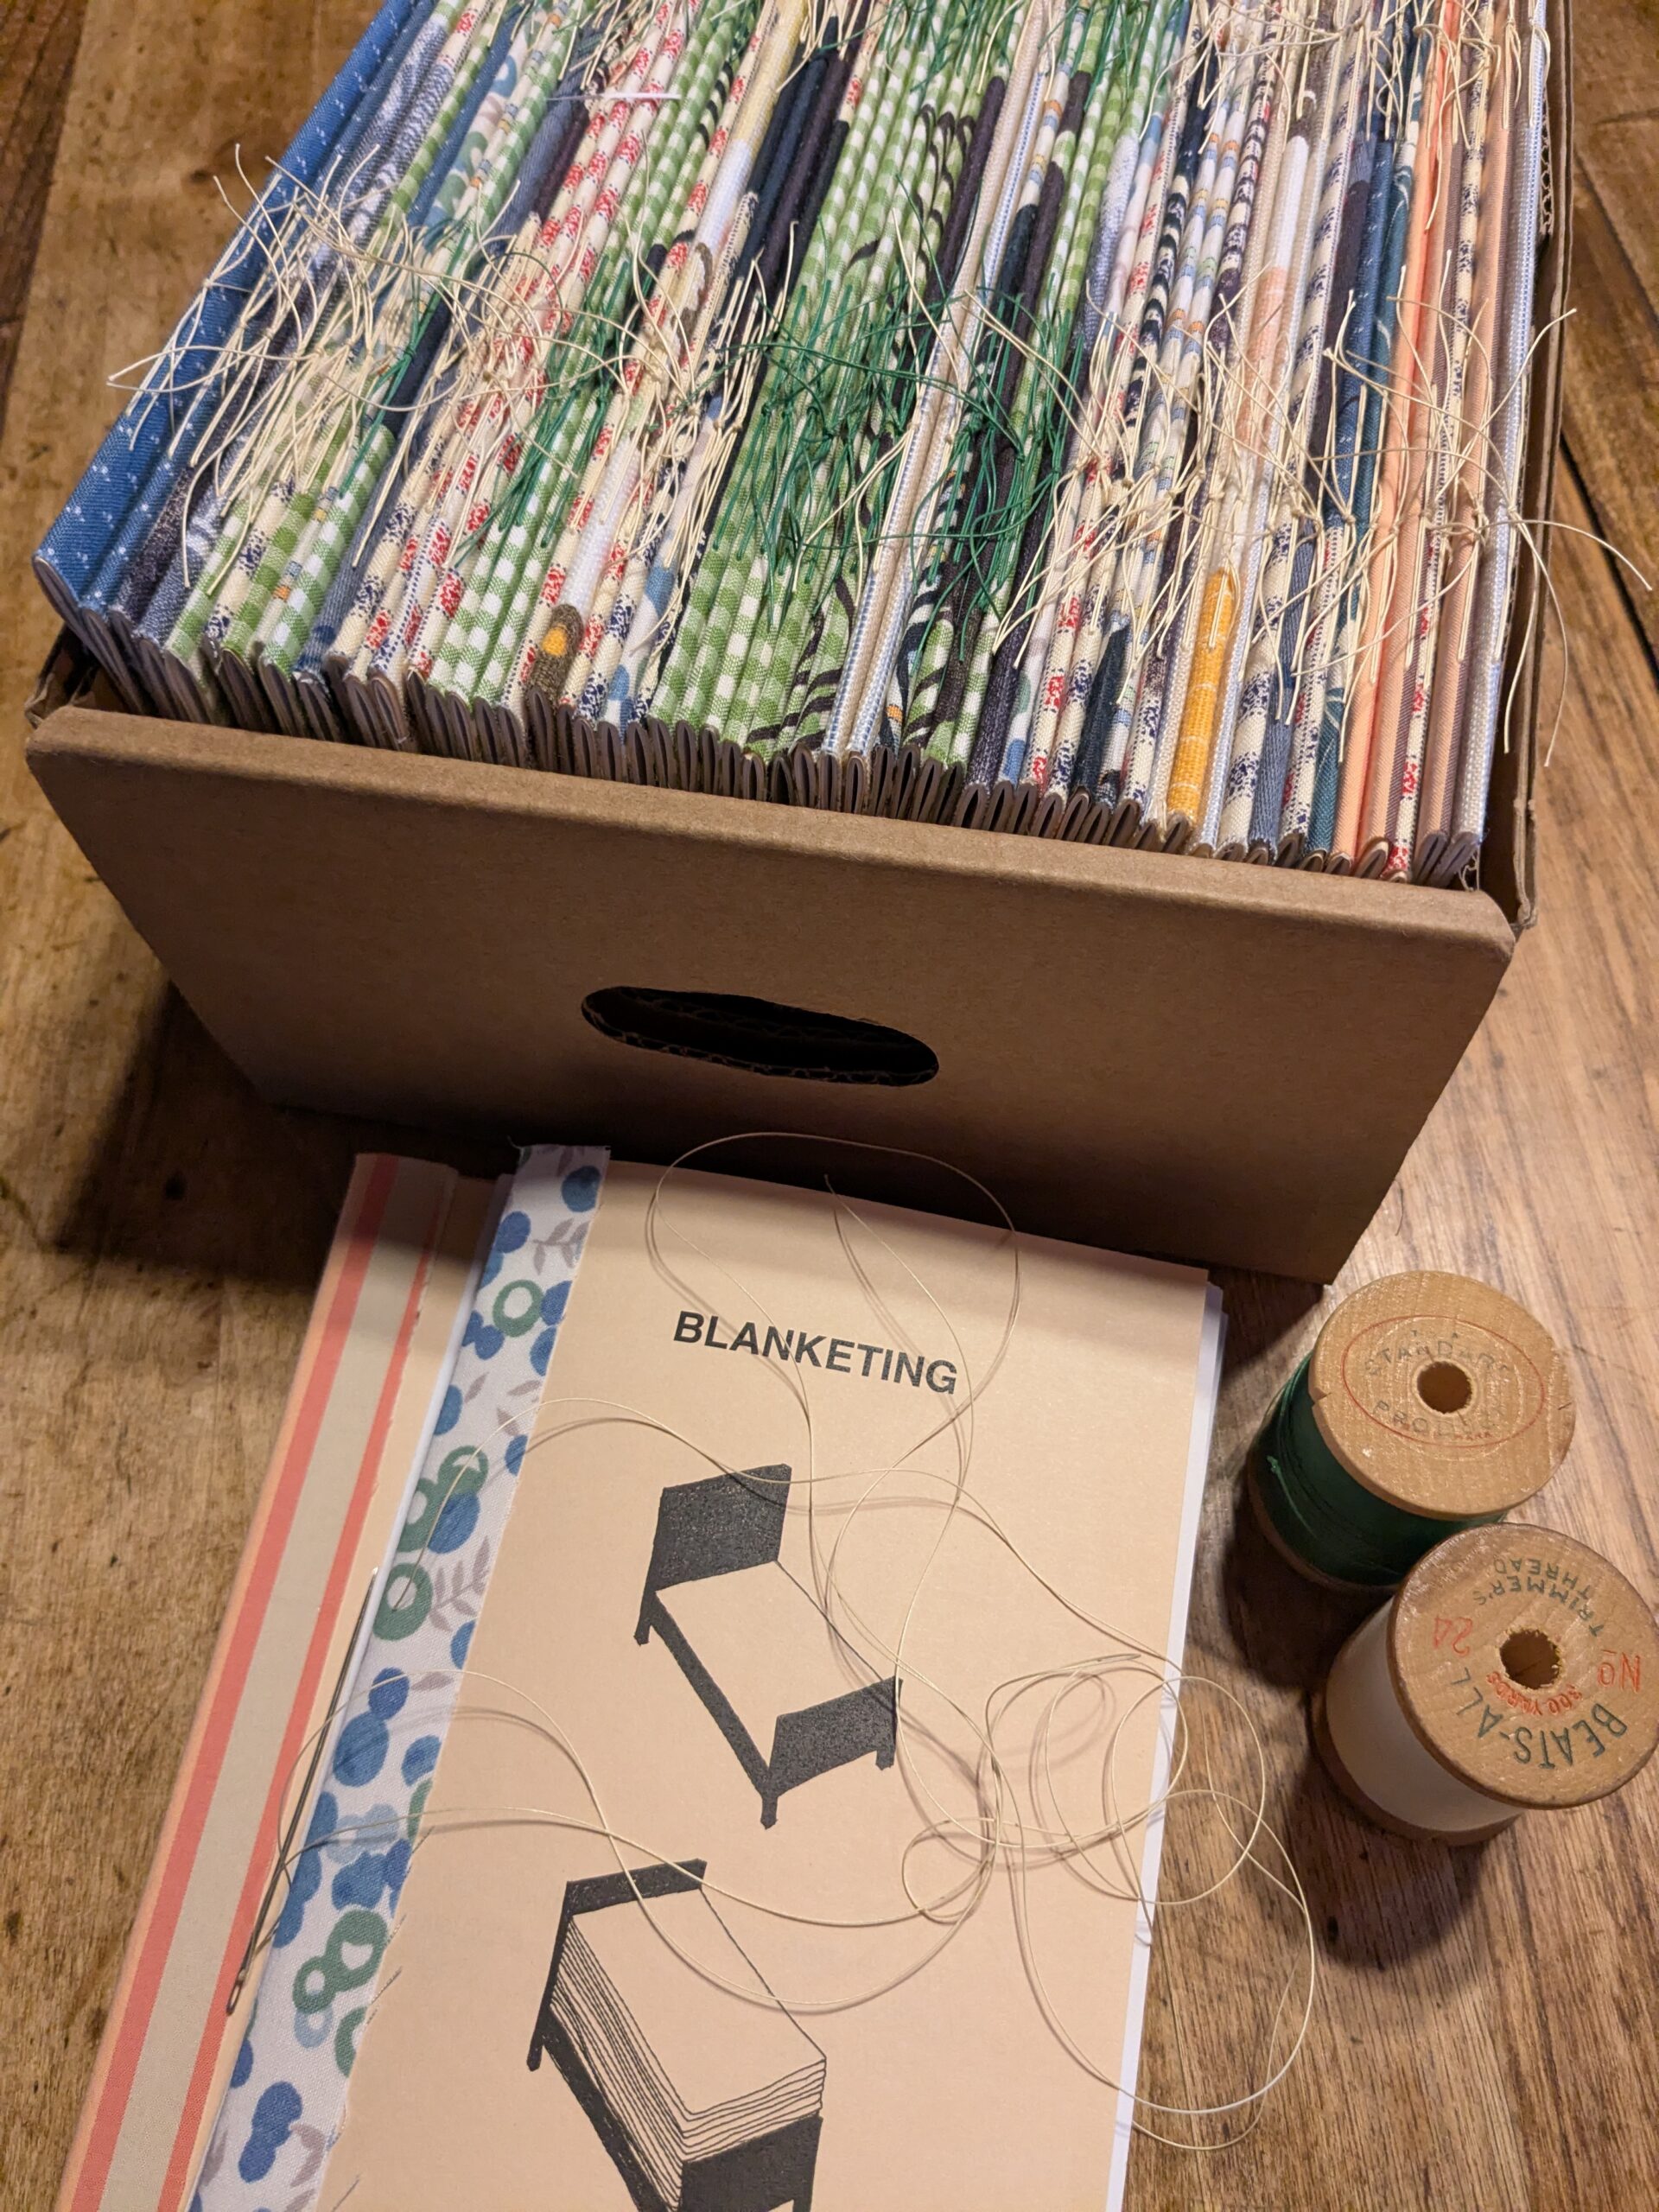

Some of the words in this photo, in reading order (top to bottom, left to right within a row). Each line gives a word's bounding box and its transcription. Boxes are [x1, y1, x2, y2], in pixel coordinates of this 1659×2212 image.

[673, 1311, 957, 1395] BLANKETING
[1492, 1558, 1592, 1600] THREAD
[1471, 1575, 1604, 1637] TRIMMER'S
[1433, 1617, 1473, 1657] 24
[1485, 1672, 1544, 1717] YARDS
[1545, 1684, 1583, 1716] 300
[1450, 1667, 1628, 1770] BEATS-ALL
